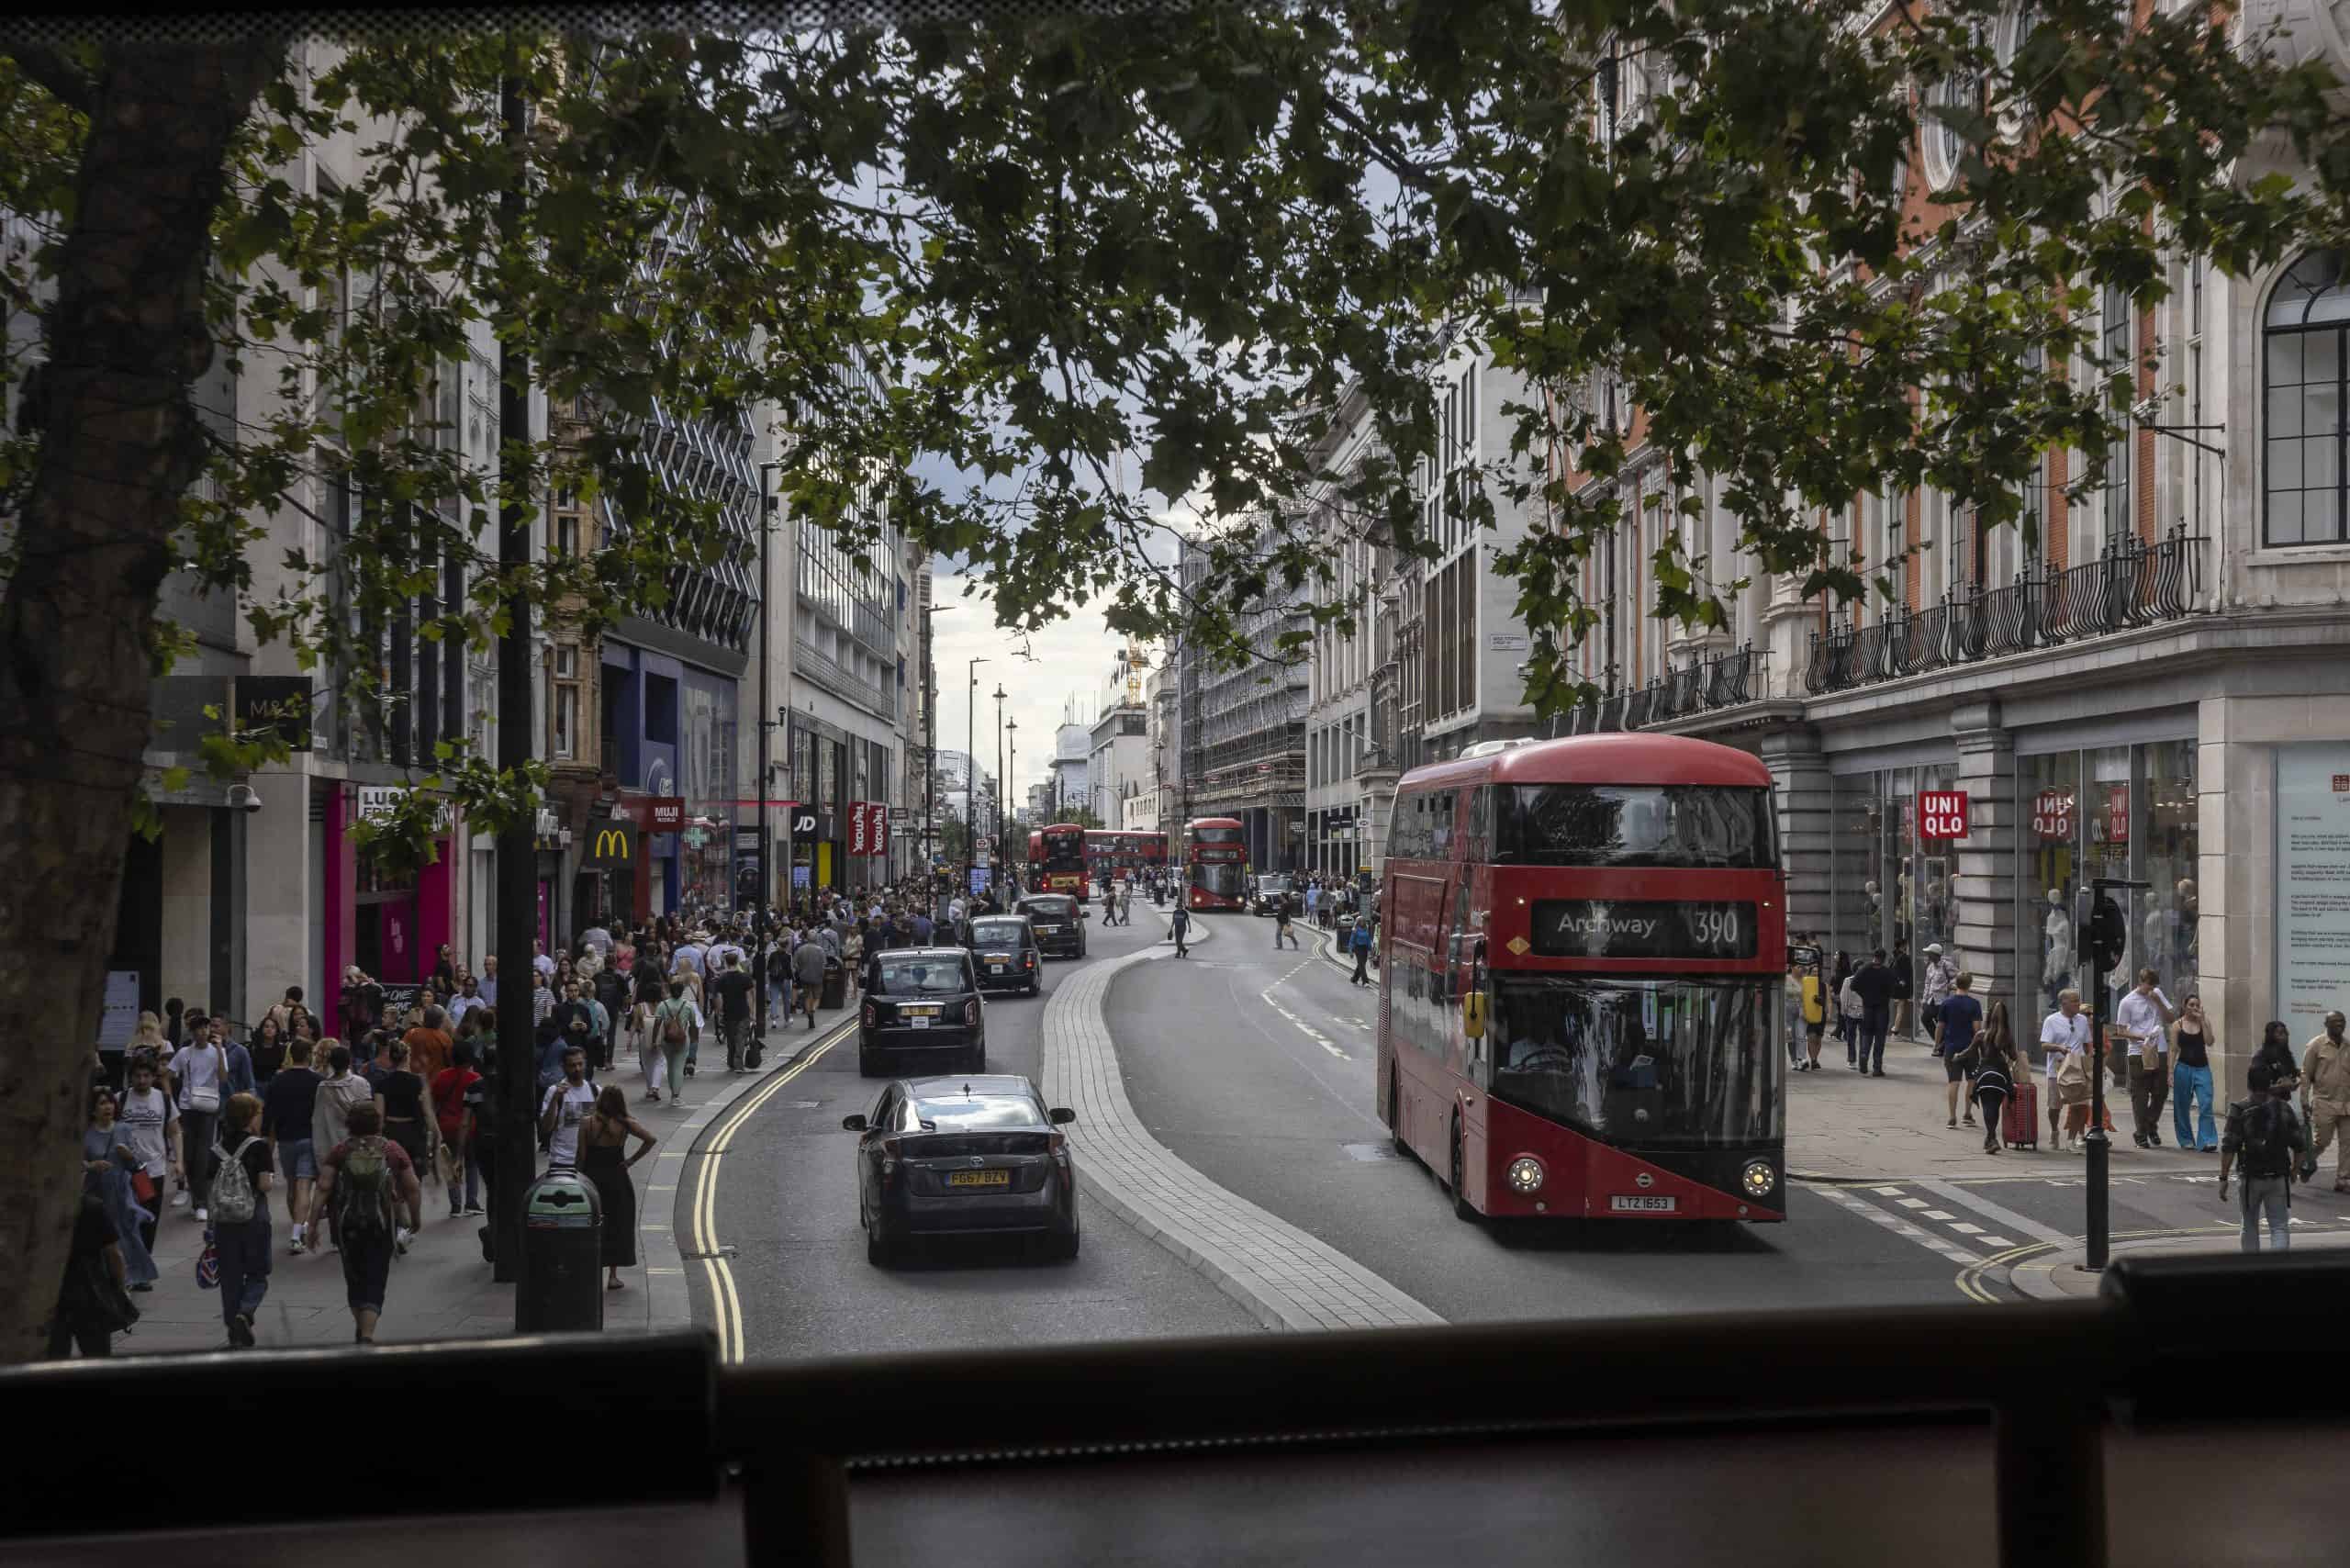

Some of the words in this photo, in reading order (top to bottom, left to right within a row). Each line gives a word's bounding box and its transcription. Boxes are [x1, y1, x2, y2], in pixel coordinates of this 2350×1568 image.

[655, 806, 678, 817] MUJI
[1925, 796, 1959, 813] UNI
[793, 815, 816, 832] JD
[1925, 816, 1963, 836] QLO
[1558, 913, 1657, 939] Archway
[1695, 911, 1738, 943] 390
